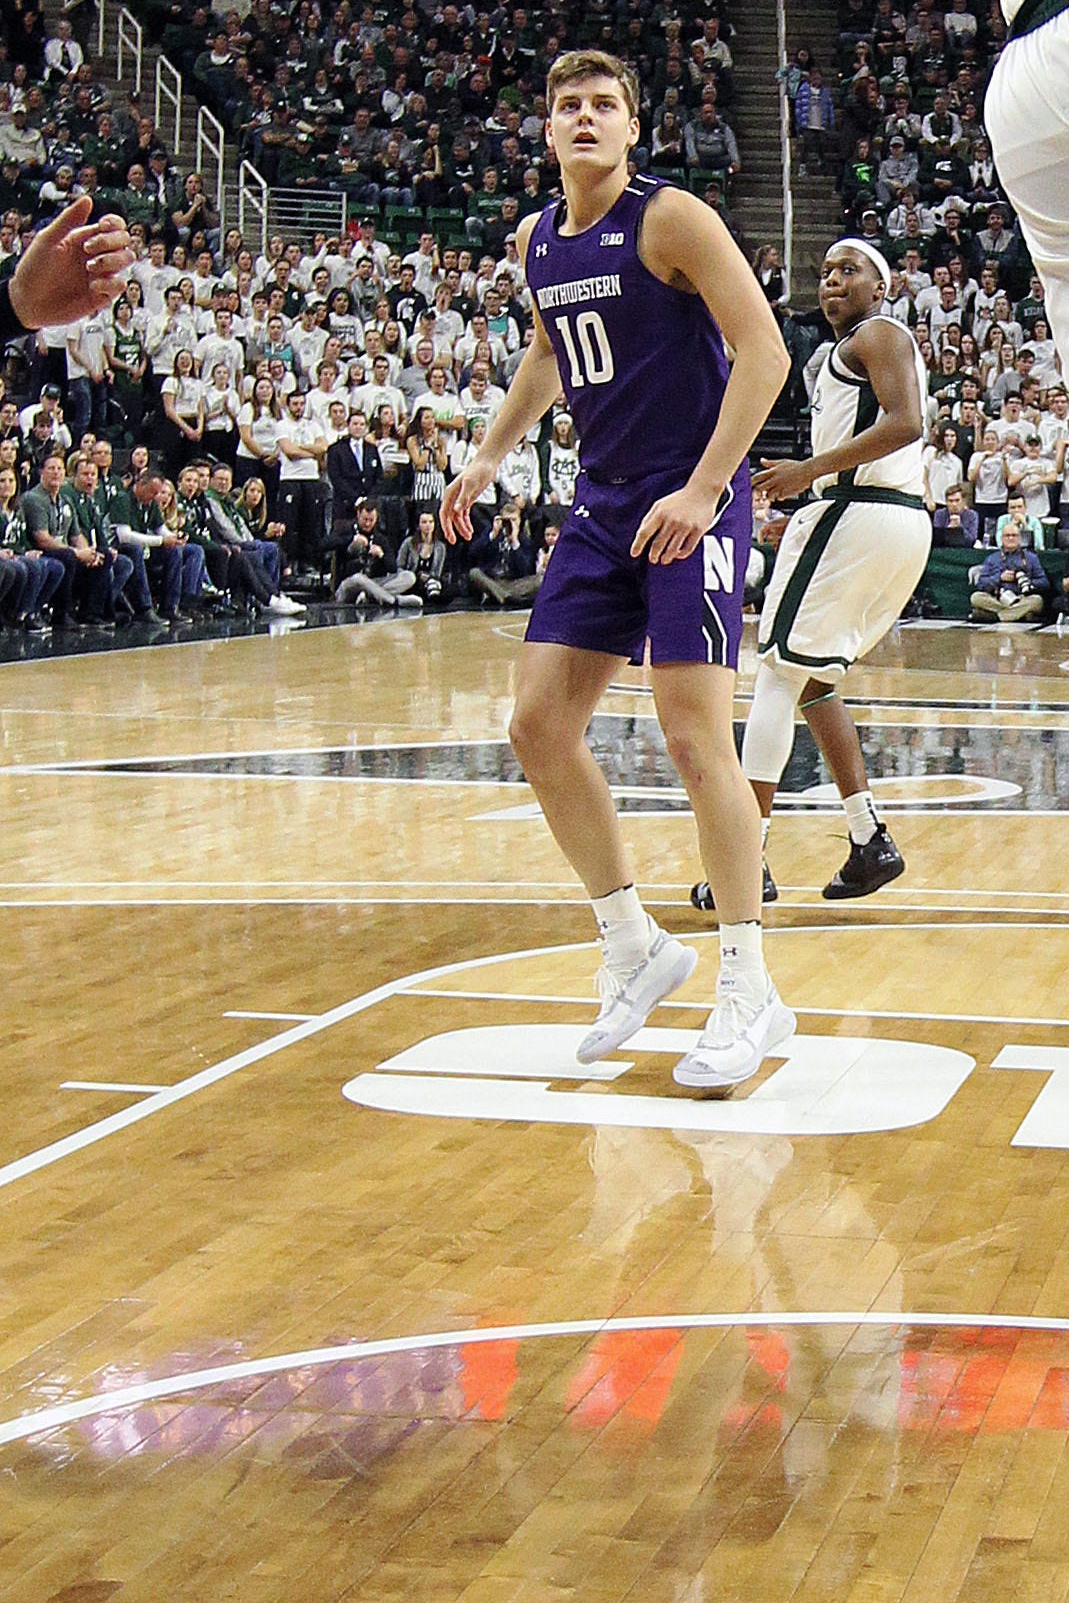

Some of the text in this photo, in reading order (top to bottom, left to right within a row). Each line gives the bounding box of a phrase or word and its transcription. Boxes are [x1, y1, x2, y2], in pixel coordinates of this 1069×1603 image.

[536, 274, 622, 310] NORTHWESTERN
[554, 310, 615, 388] 10
[702, 534, 735, 594] N
